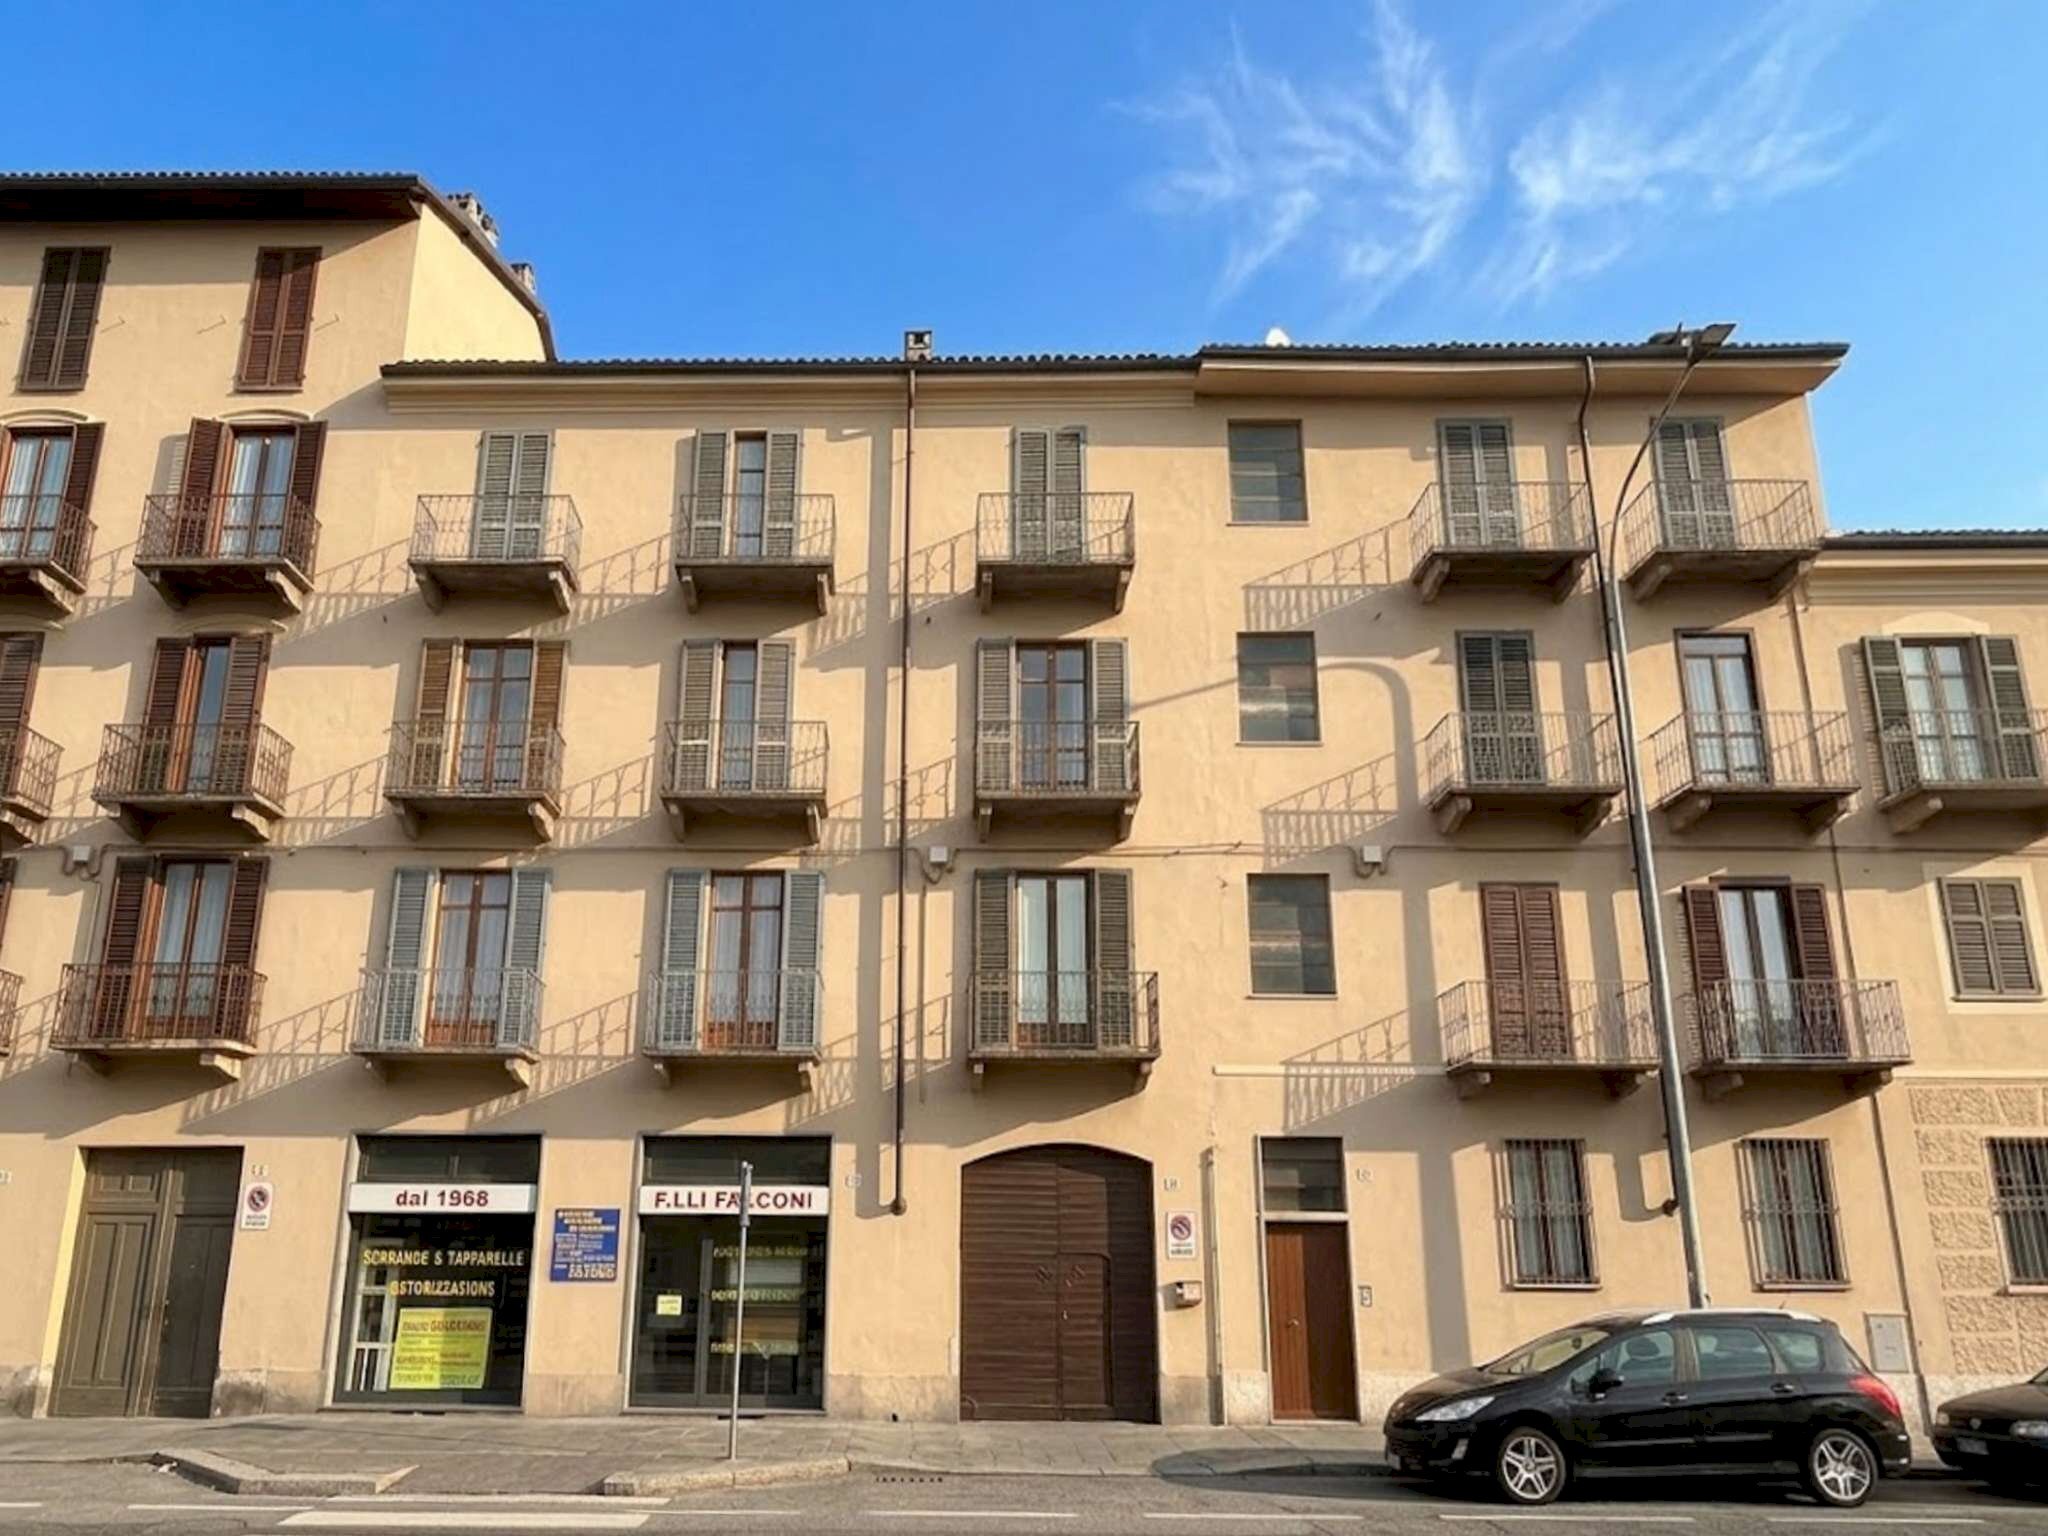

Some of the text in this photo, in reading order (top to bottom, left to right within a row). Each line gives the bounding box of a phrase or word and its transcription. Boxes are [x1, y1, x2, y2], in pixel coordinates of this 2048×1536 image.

[396, 1190, 489, 1207] dal 1968
[654, 1191, 812, 1209] F.LLI FACONI
[447, 1250, 525, 1266] TAPPARELLE
